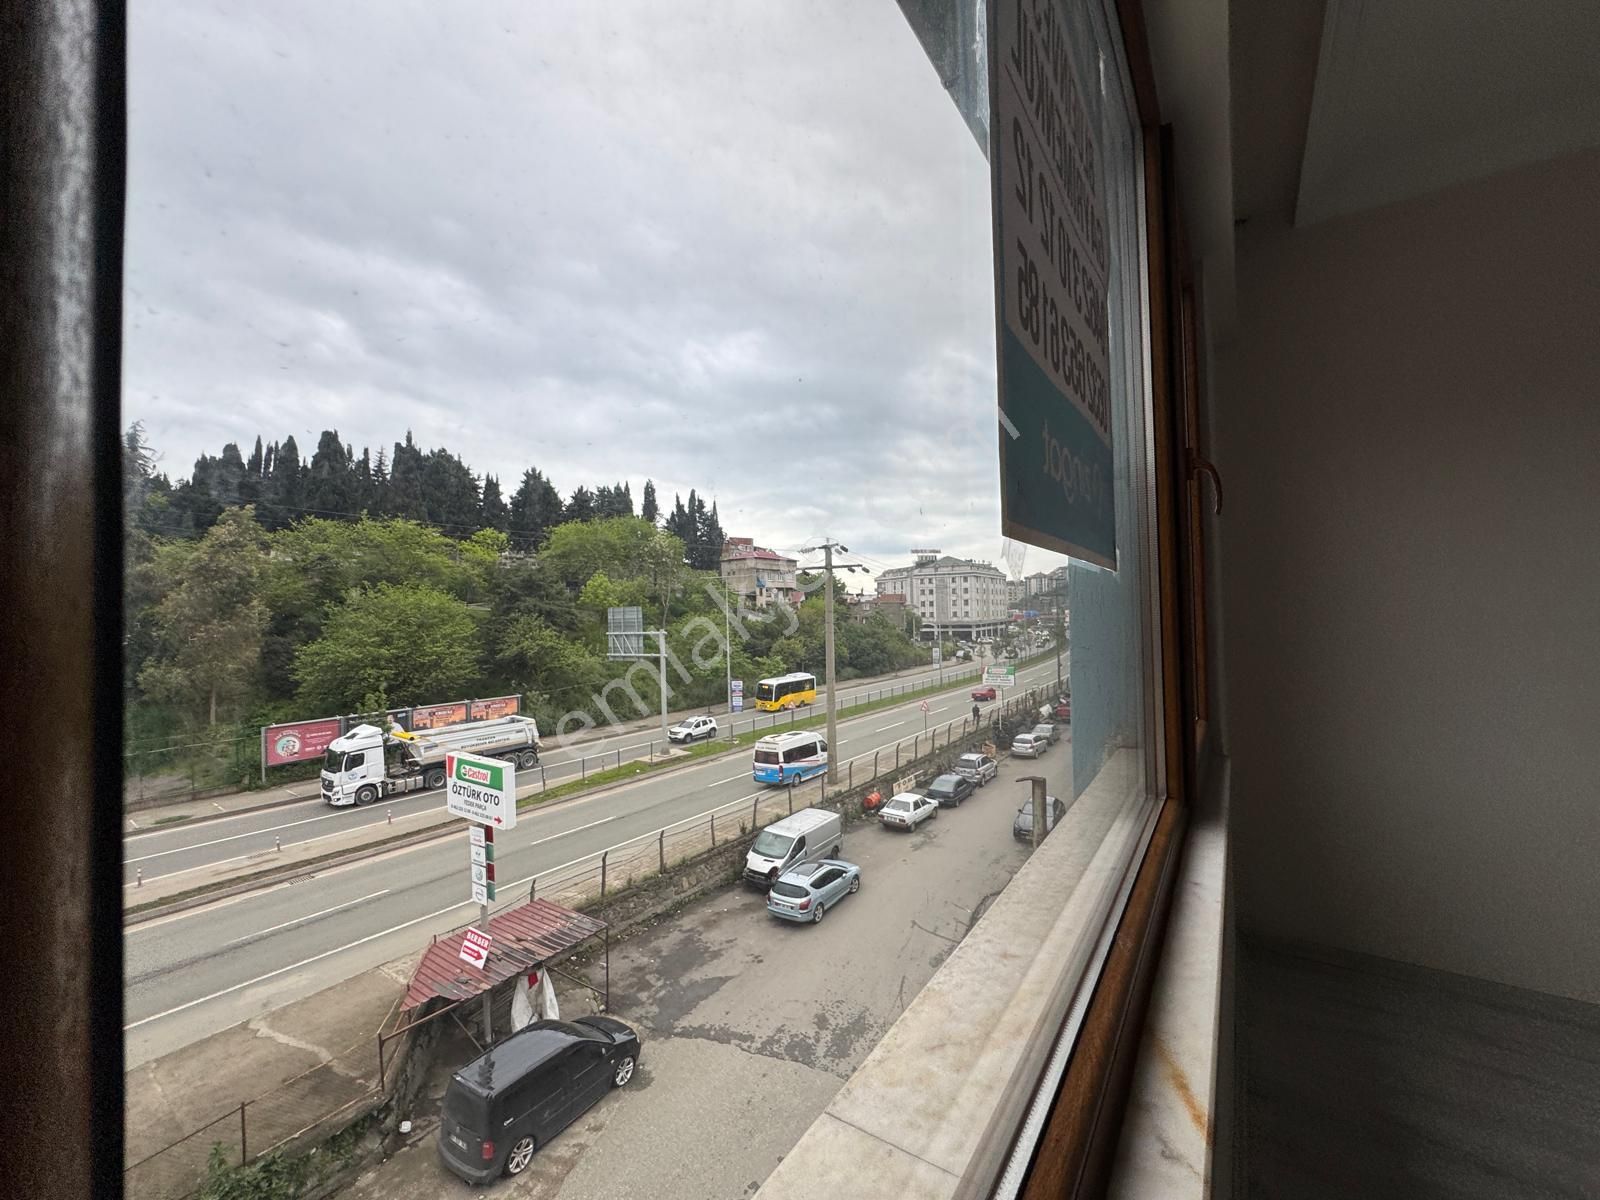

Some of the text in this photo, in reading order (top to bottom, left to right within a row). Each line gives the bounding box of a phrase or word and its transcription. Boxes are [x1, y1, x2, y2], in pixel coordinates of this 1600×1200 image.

[467, 767, 489, 782] Castrol
[452, 781, 500, 806] ÖZTÜRK OTO
[466, 930, 490, 949] BERBER
